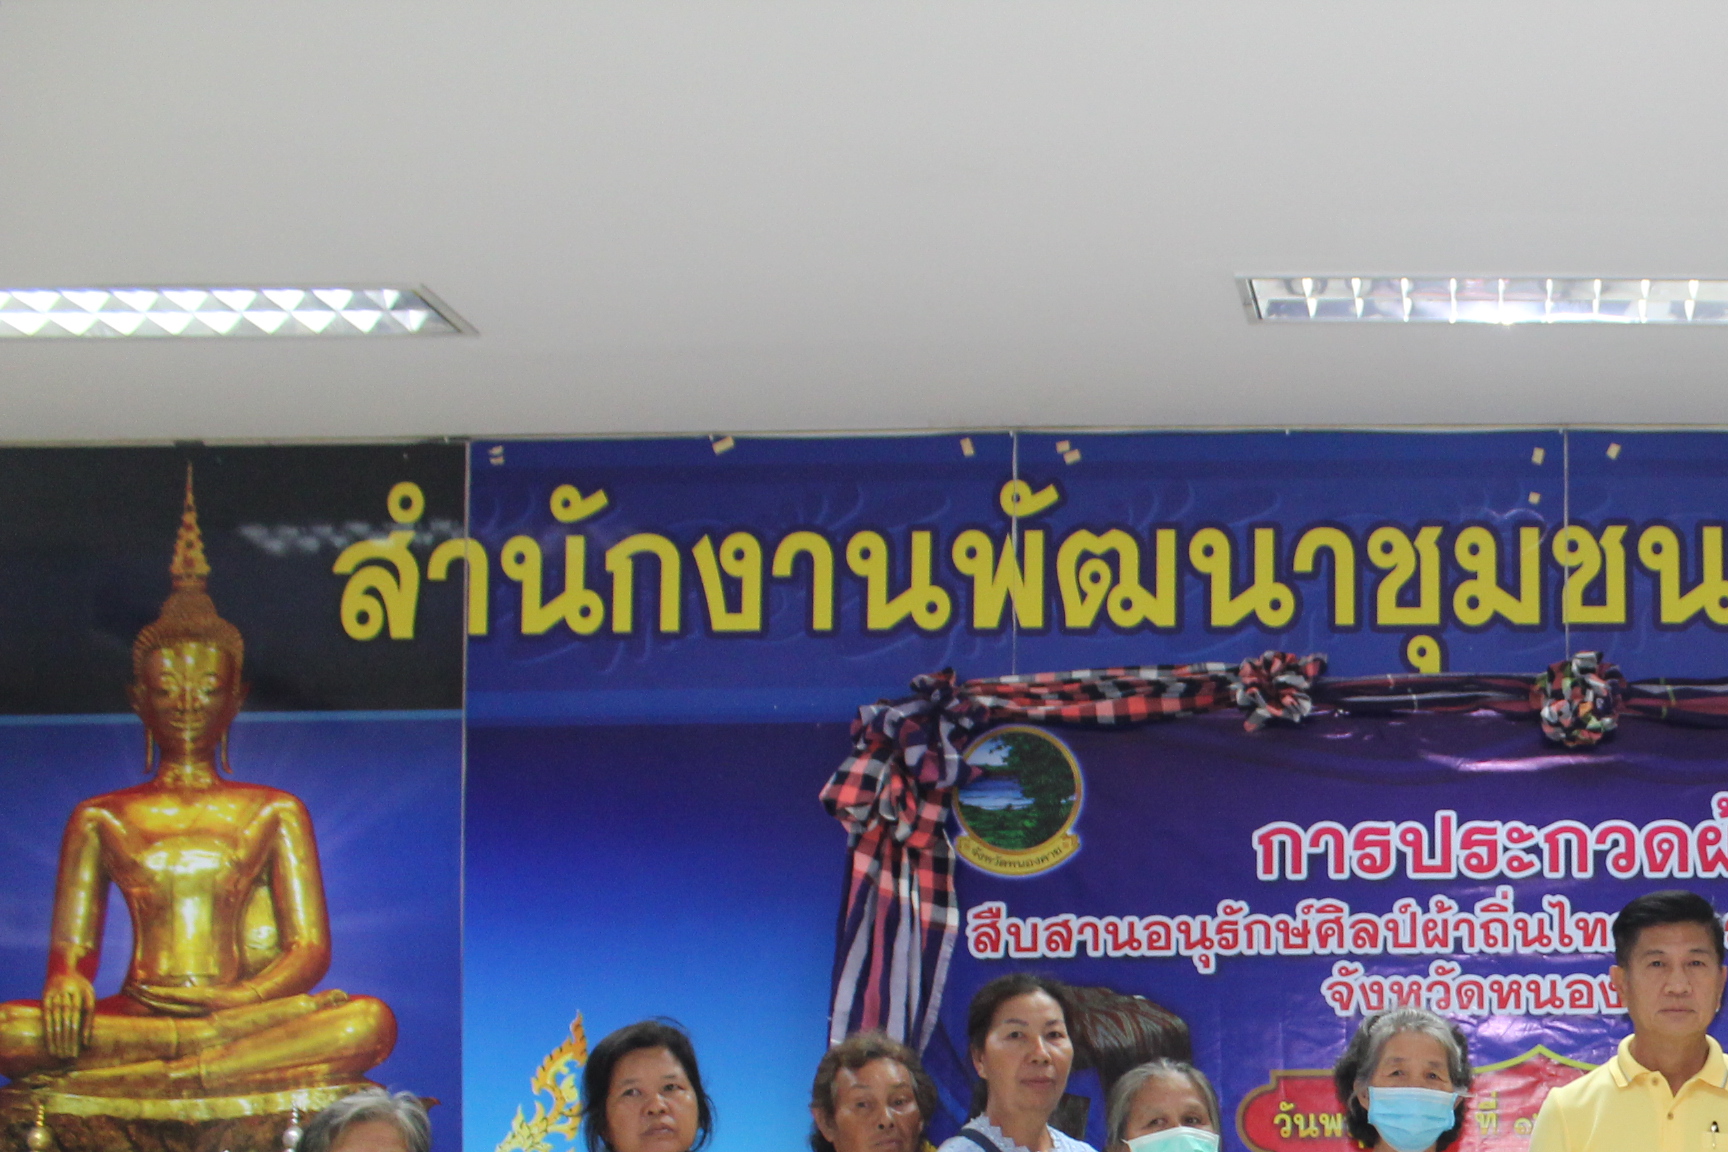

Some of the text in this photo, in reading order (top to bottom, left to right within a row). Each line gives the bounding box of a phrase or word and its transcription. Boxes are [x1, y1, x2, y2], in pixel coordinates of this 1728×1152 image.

[970, 893, 1612, 970] สืบสานอนุรักษ์ศิลป์ผ้าถิ่นไท
[1325, 962, 1625, 1014] จังหวัดหนอง
